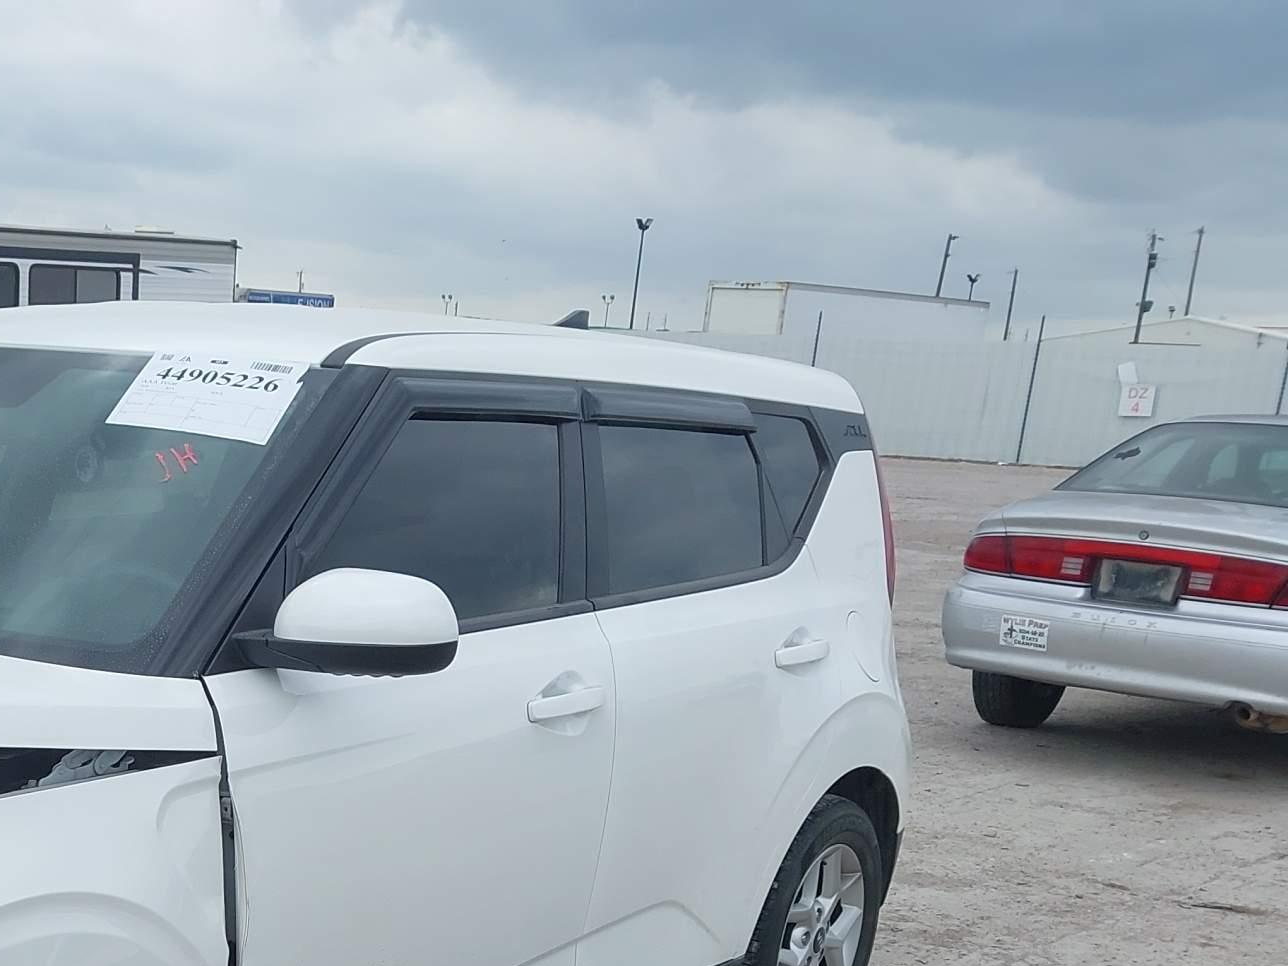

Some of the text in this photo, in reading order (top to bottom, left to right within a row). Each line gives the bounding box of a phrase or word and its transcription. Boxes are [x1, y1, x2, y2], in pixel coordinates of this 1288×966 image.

[156, 367, 279, 393] 44905226
[1128, 387, 1149, 400] DZ
[1130, 402, 1140, 413] 4
